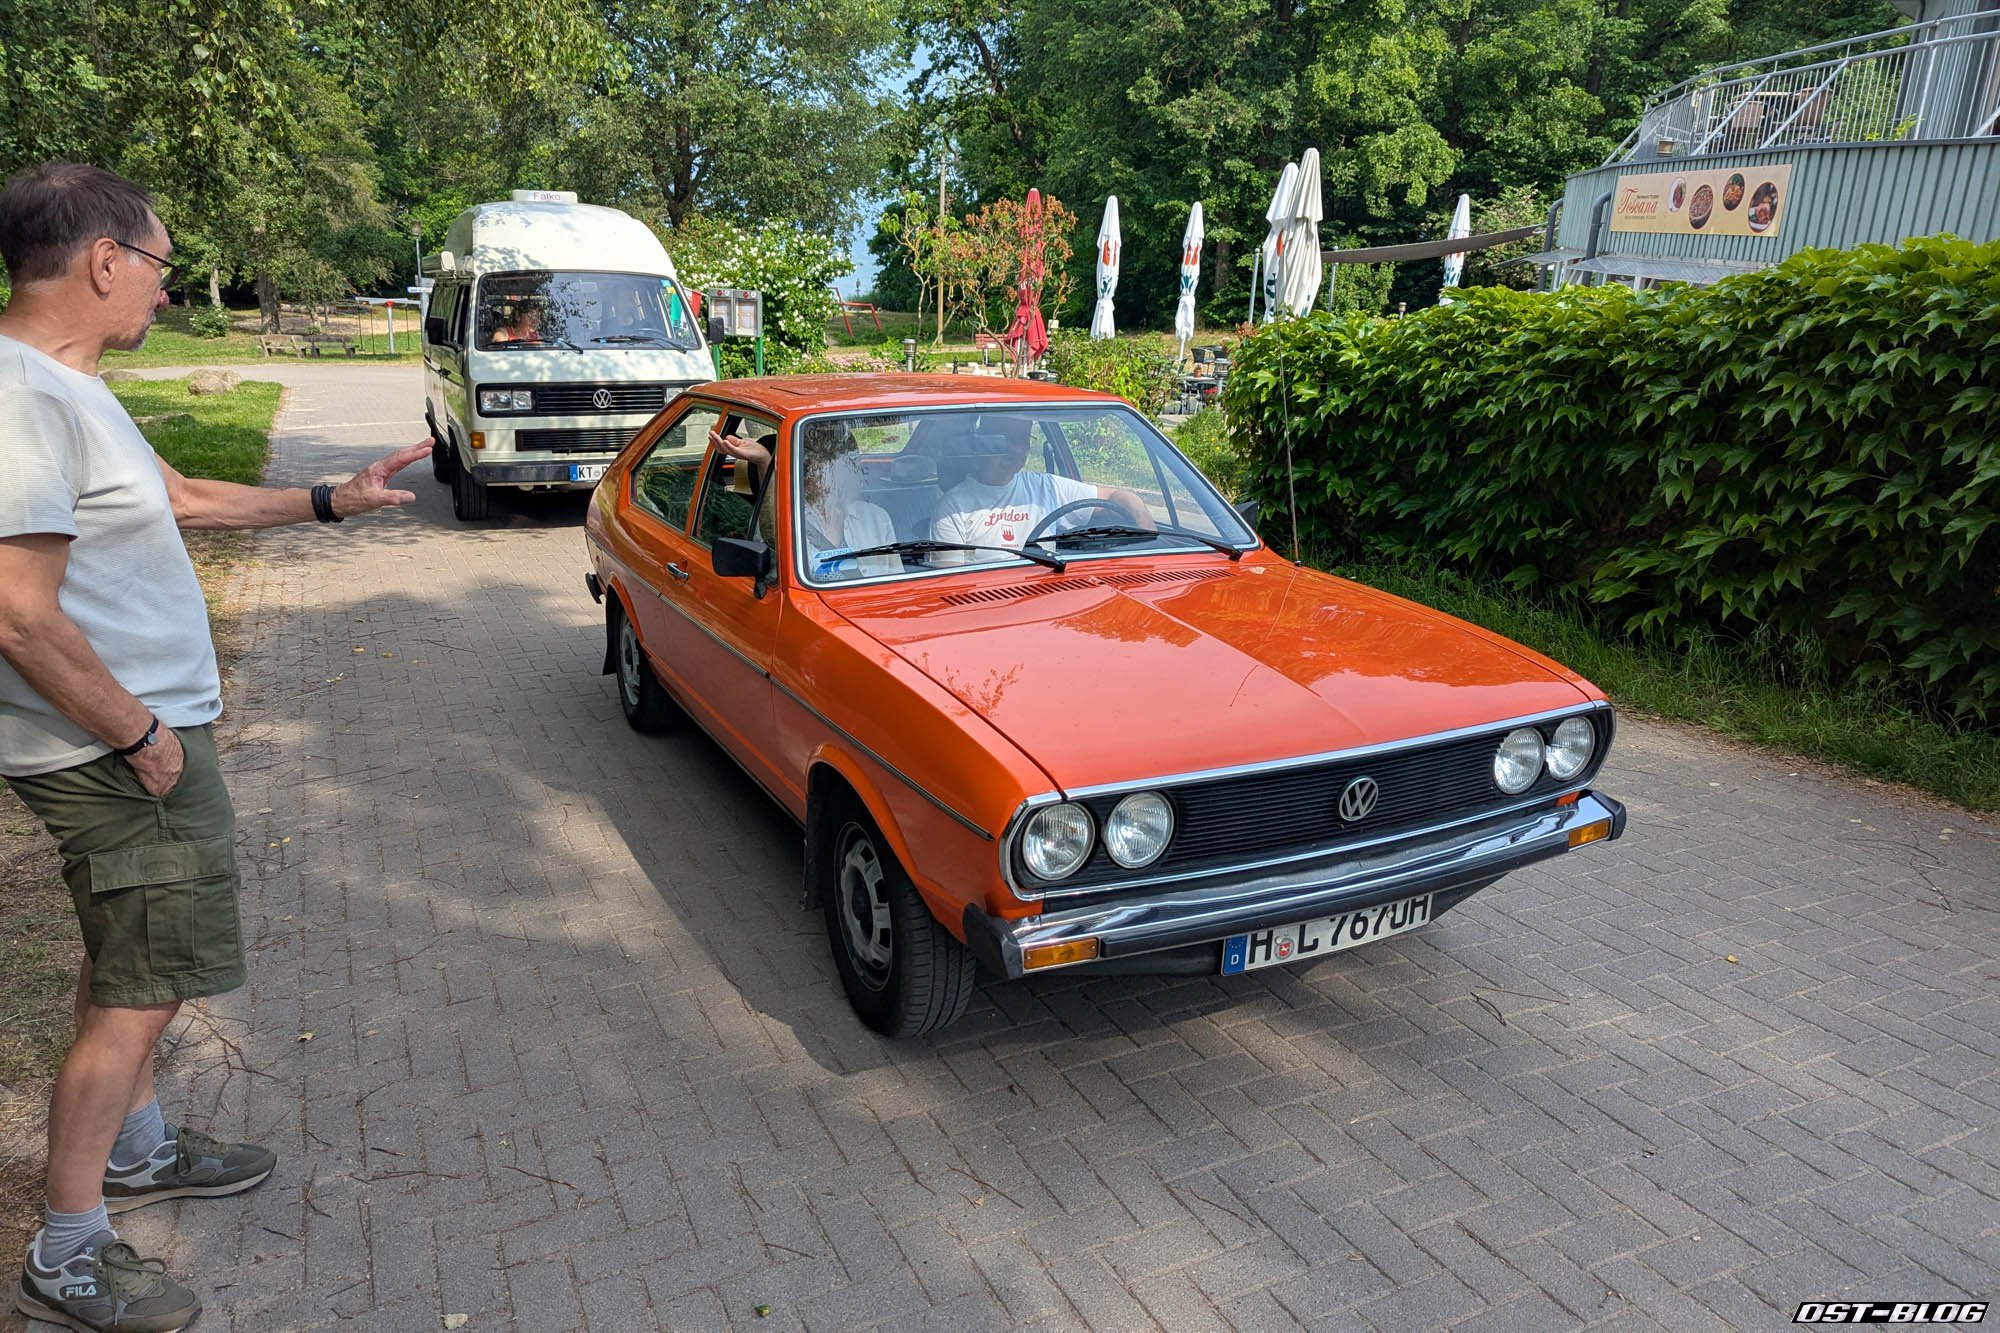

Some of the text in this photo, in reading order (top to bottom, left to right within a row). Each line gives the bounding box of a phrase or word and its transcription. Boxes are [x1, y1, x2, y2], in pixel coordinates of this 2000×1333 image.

[593, 389, 612, 408] VW
[578, 466, 593, 478] KT
[1339, 777, 1379, 821] VW
[1231, 954, 1239, 965] D
[1249, 930, 1273, 964] H
[1297, 924, 1319, 954] L
[66, 1284, 97, 1297] FILA
